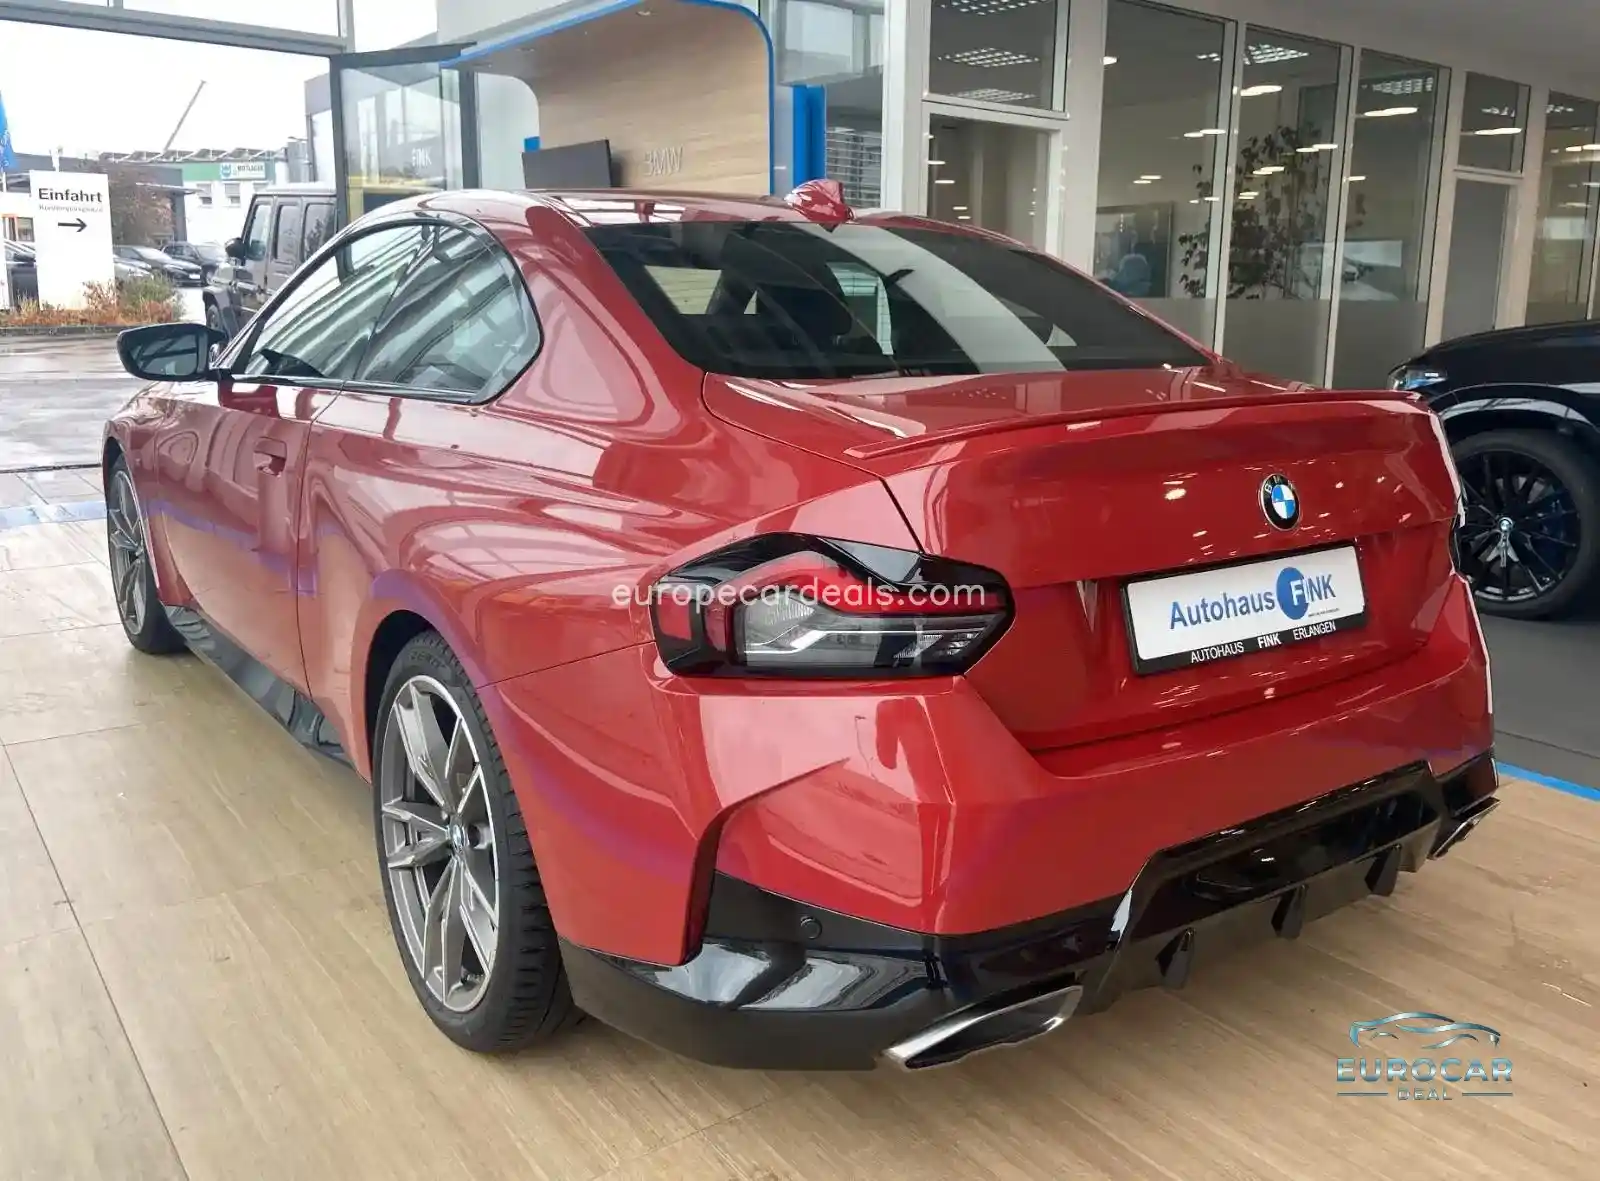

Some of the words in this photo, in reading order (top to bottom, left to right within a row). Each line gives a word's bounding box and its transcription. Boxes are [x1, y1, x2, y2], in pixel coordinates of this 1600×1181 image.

[38, 188, 103, 203] Einfahrt
[1169, 590, 1276, 630] Autohaus
[1289, 573, 1337, 606] FINK
[1190, 641, 1245, 664] AUTOHAUS
[1257, 632, 1282, 649] FINK
[1292, 620, 1337, 641] ERLANGEN
